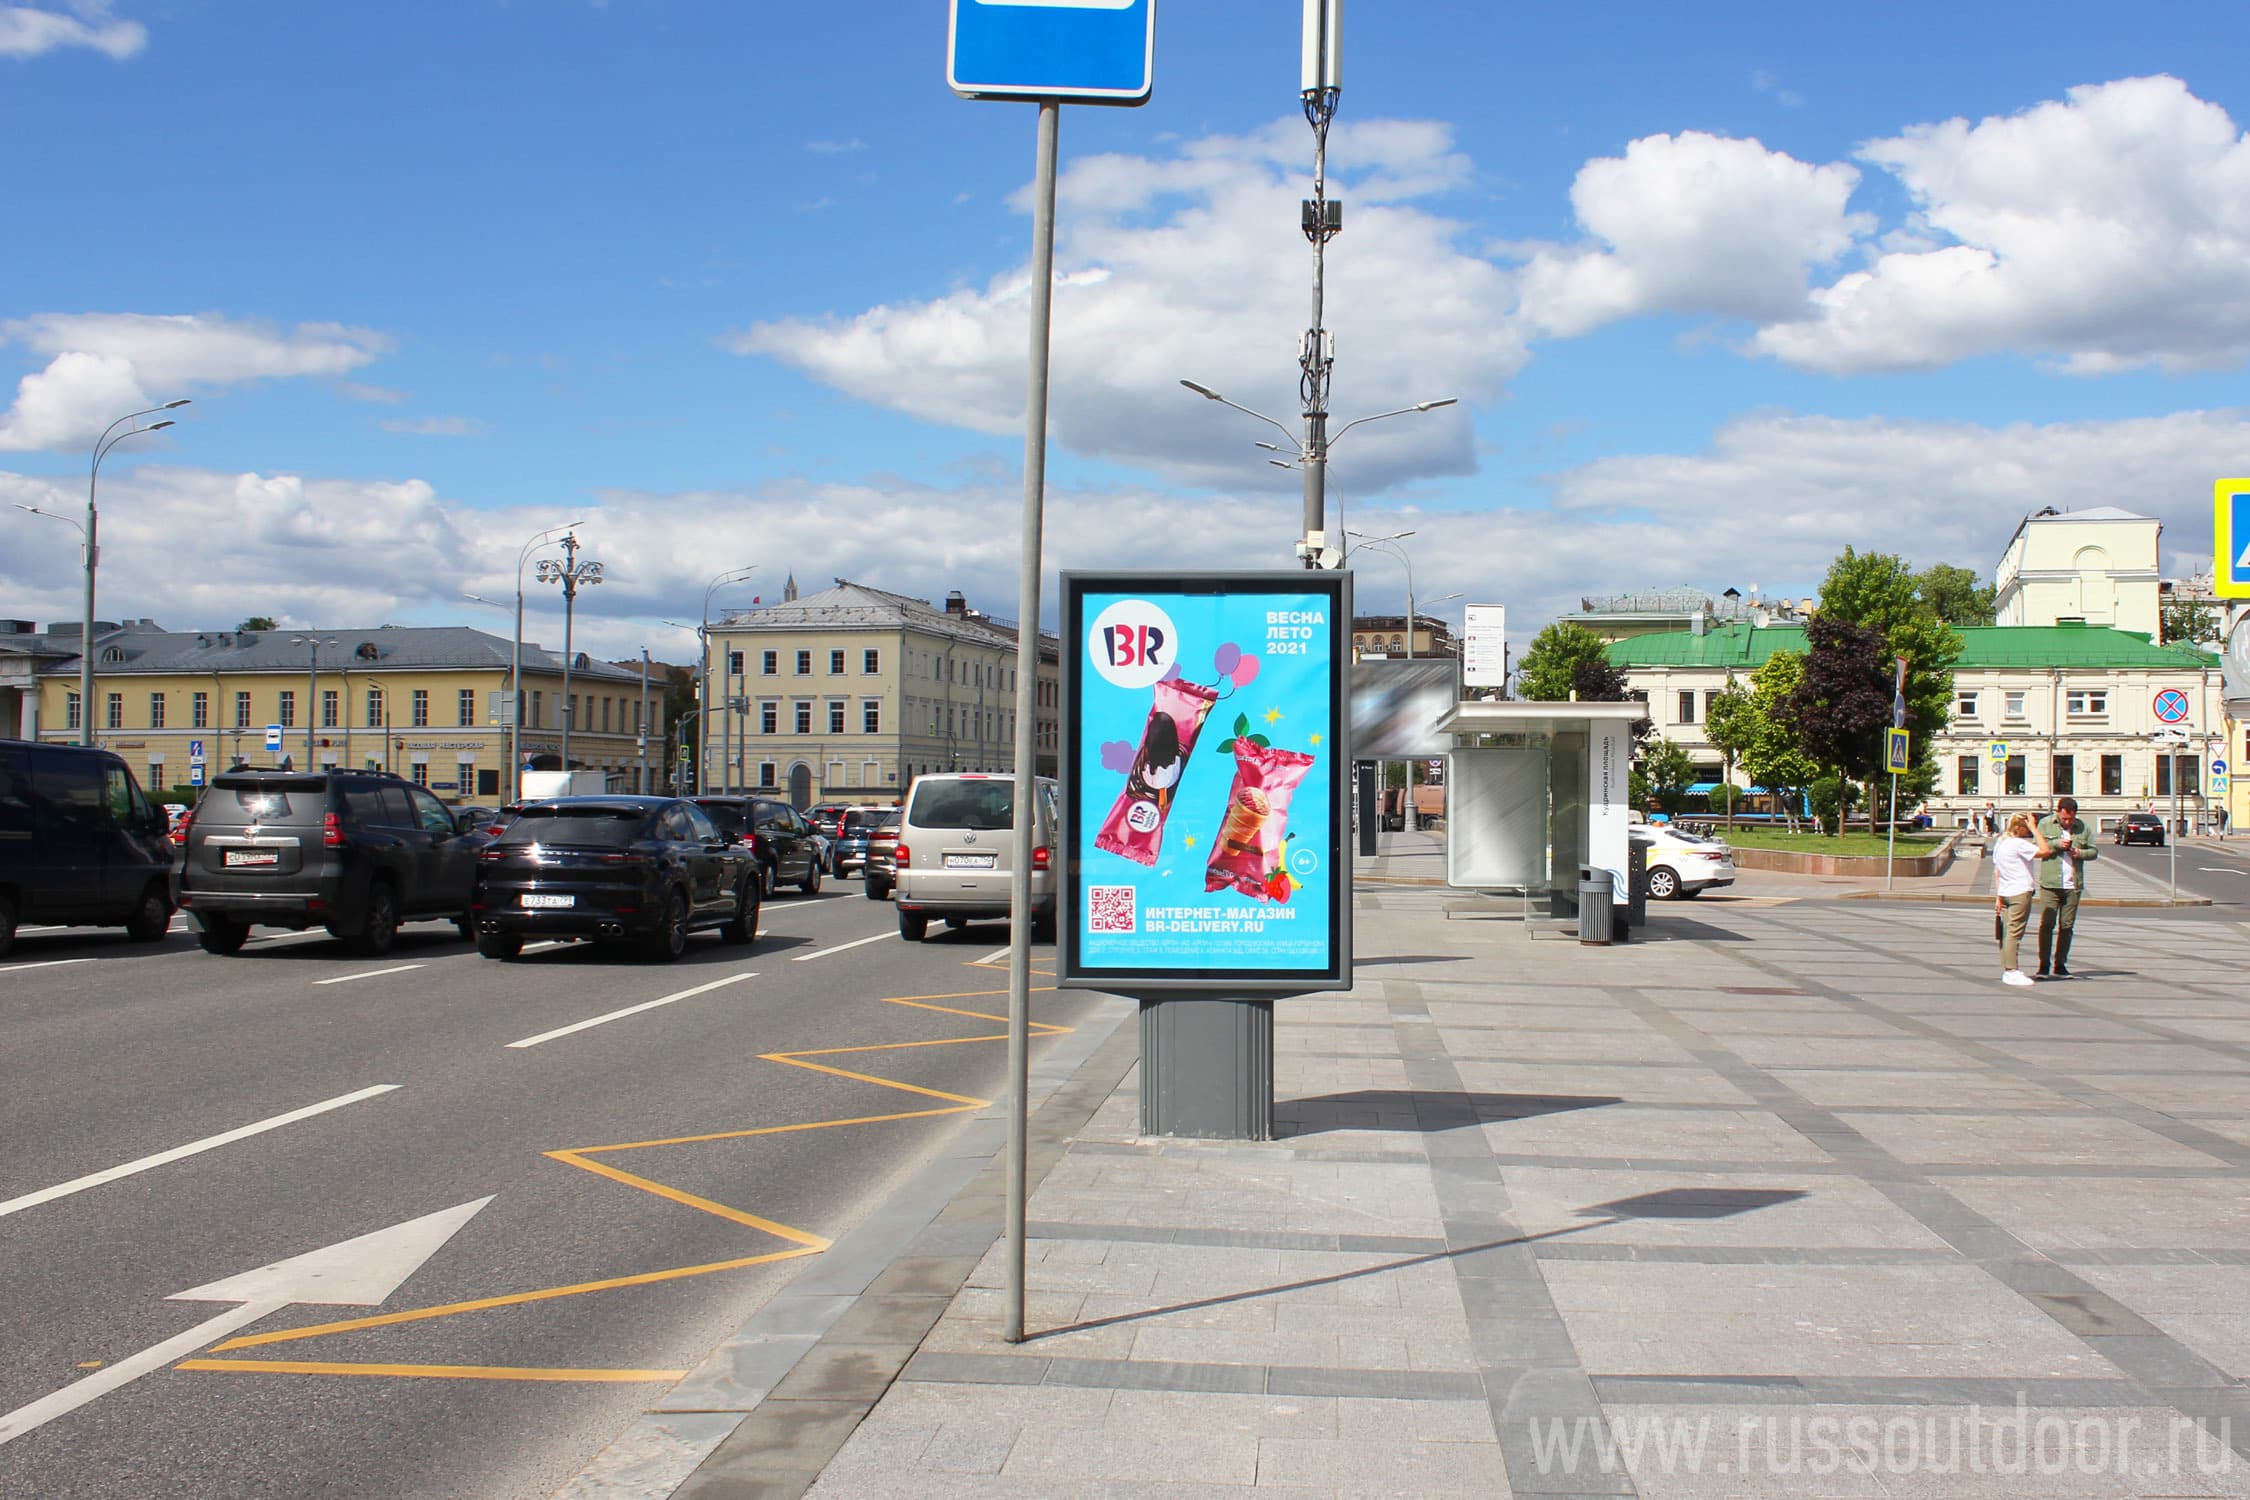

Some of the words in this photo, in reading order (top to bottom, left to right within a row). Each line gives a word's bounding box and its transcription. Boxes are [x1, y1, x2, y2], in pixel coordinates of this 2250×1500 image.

[1266, 611, 1325, 624] ВЕСНА
[1266, 626, 1313, 639] ЛЕТО
[1104, 624, 1164, 667] BR
[1266, 642, 1307, 655] 2021
[1146, 907, 1296, 920] ИНТЕРНЕТ-МАГАЗИН
[1146, 920, 1264, 933] BR-DELIVERY.RU
